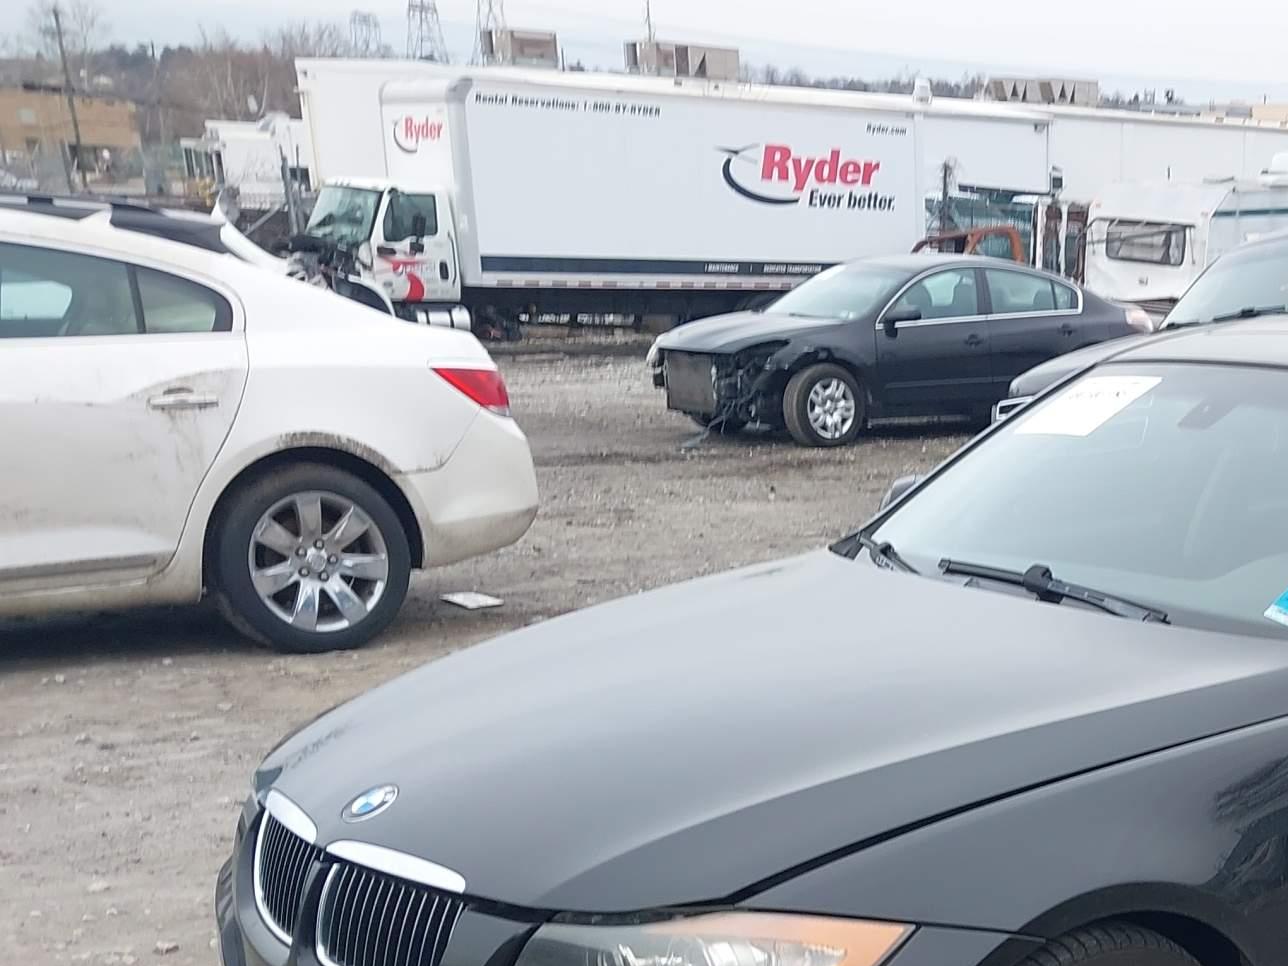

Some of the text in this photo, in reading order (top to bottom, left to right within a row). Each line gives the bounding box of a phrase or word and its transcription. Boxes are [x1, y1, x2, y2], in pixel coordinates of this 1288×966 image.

[404, 115, 443, 145] Ryder
[865, 122, 907, 136] Ryder.com
[761, 144, 881, 192] Ryder
[808, 188, 896, 211] Ever better.
